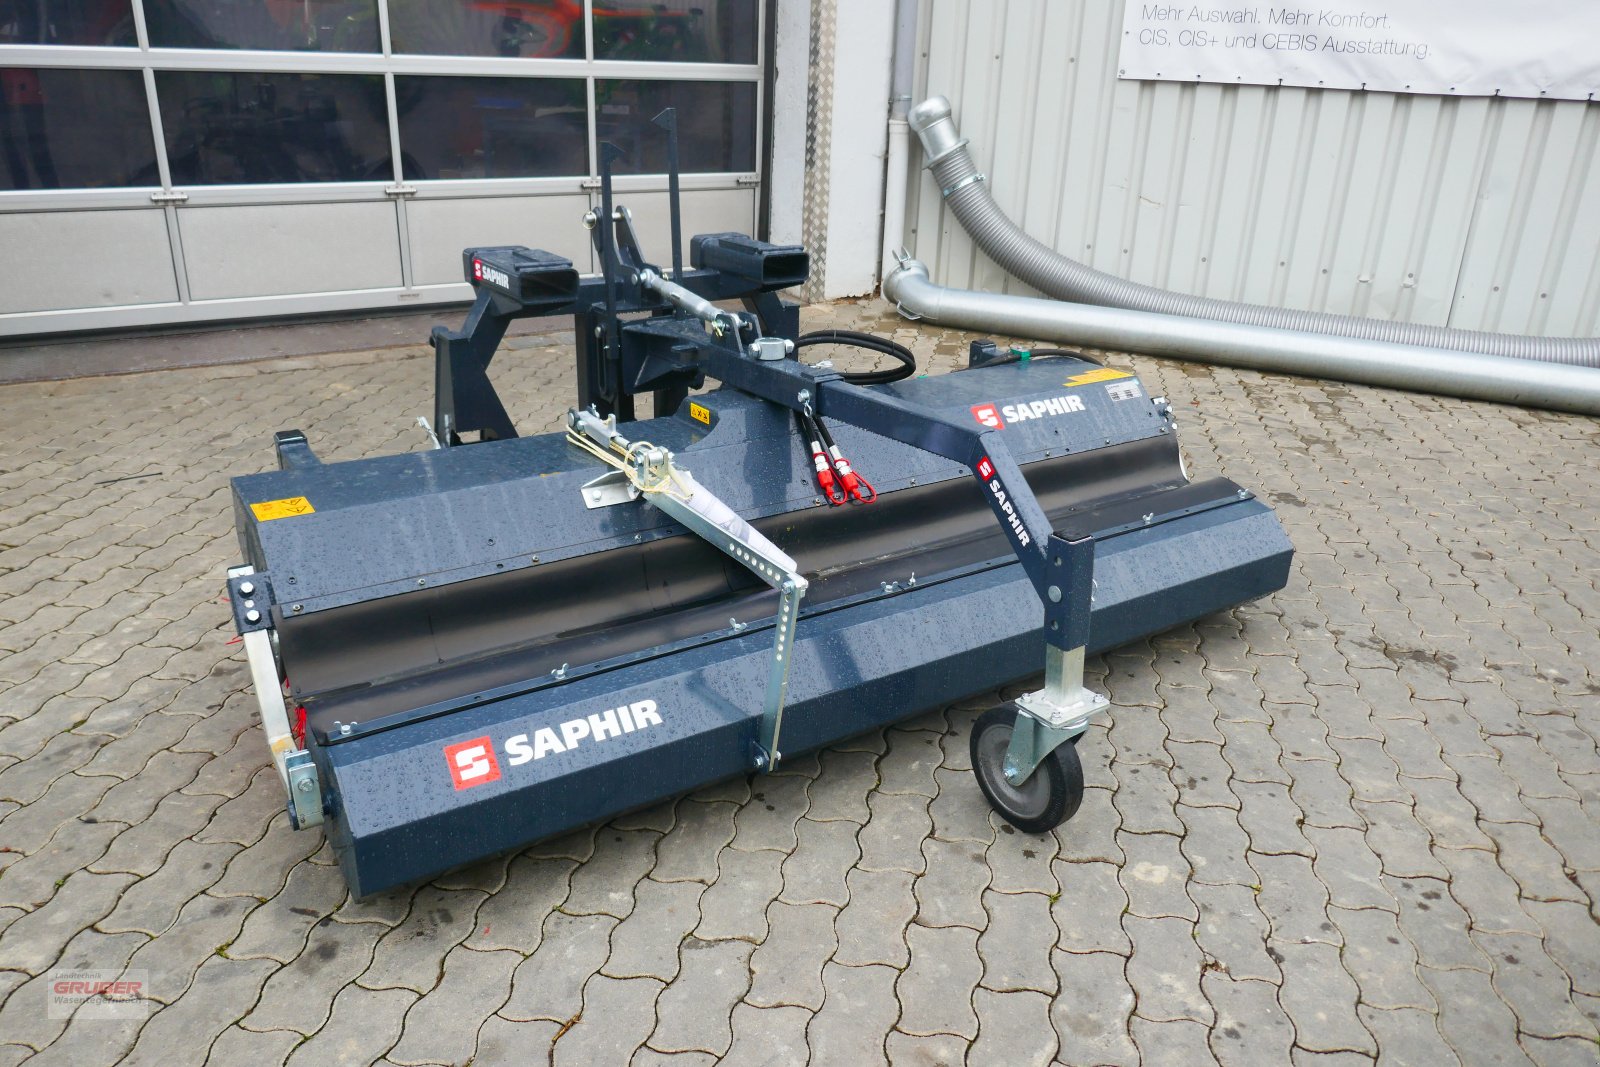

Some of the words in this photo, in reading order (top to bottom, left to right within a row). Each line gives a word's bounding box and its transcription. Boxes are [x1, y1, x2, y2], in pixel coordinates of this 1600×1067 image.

[1141, 4, 1184, 21] Mehr
[1187, 5, 1261, 24] Auswahl.
[1268, 8, 1314, 25] Mehr
[1318, 10, 1391, 29] Komfort.
[1178, 29, 1219, 47] CIS+
[1225, 33, 1257, 48] und
[1262, 33, 1318, 51] CEBIS
[1321, 36, 1432, 60] Ausstattung.
[481, 264, 509, 289] SAPHIR
[1002, 395, 1086, 423] SAPHIR
[989, 479, 1030, 547] SAPHIR
[504, 699, 663, 766] SAPHIR
